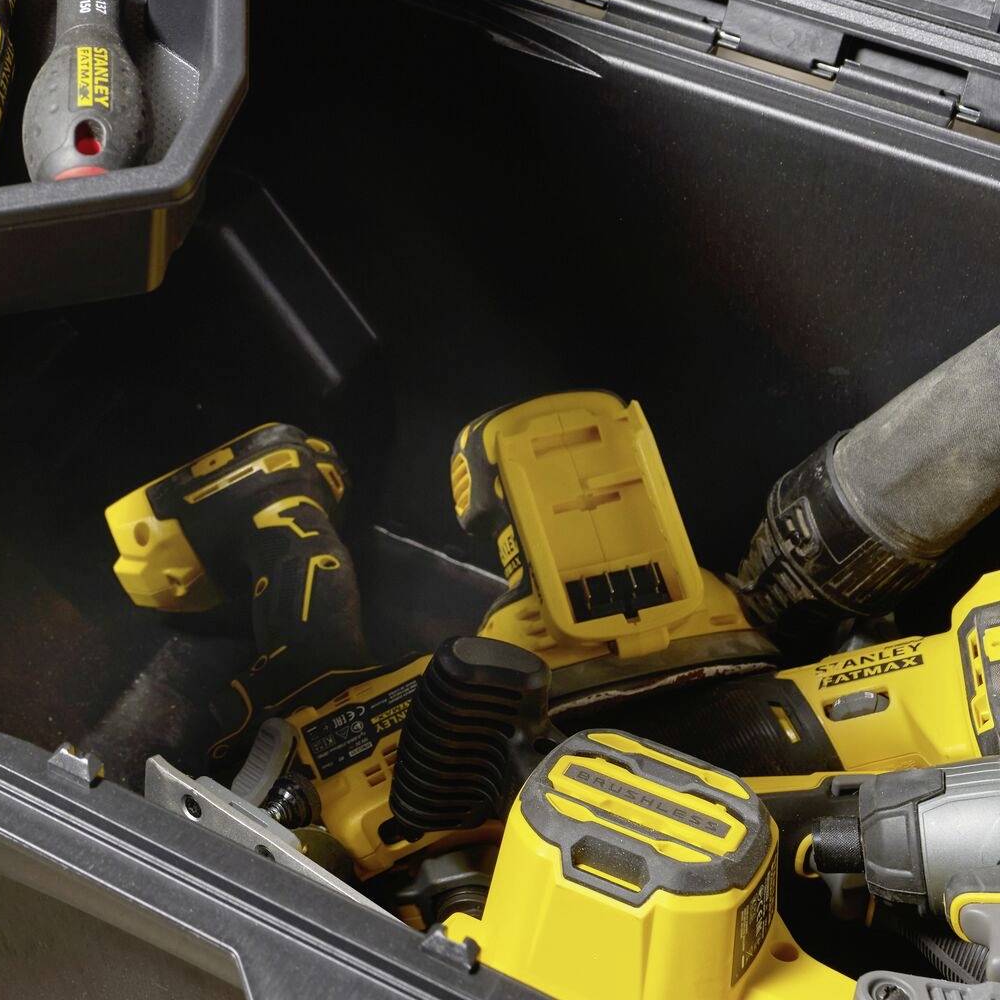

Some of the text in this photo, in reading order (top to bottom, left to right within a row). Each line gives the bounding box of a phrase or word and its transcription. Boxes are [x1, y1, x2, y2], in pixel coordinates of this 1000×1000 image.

[93, 47, 110, 108] STANLEY
[815, 642, 922, 678] STANLEY
[819, 656, 921, 689] FATMAX
[576, 770, 719, 832] BRUSHLESS
